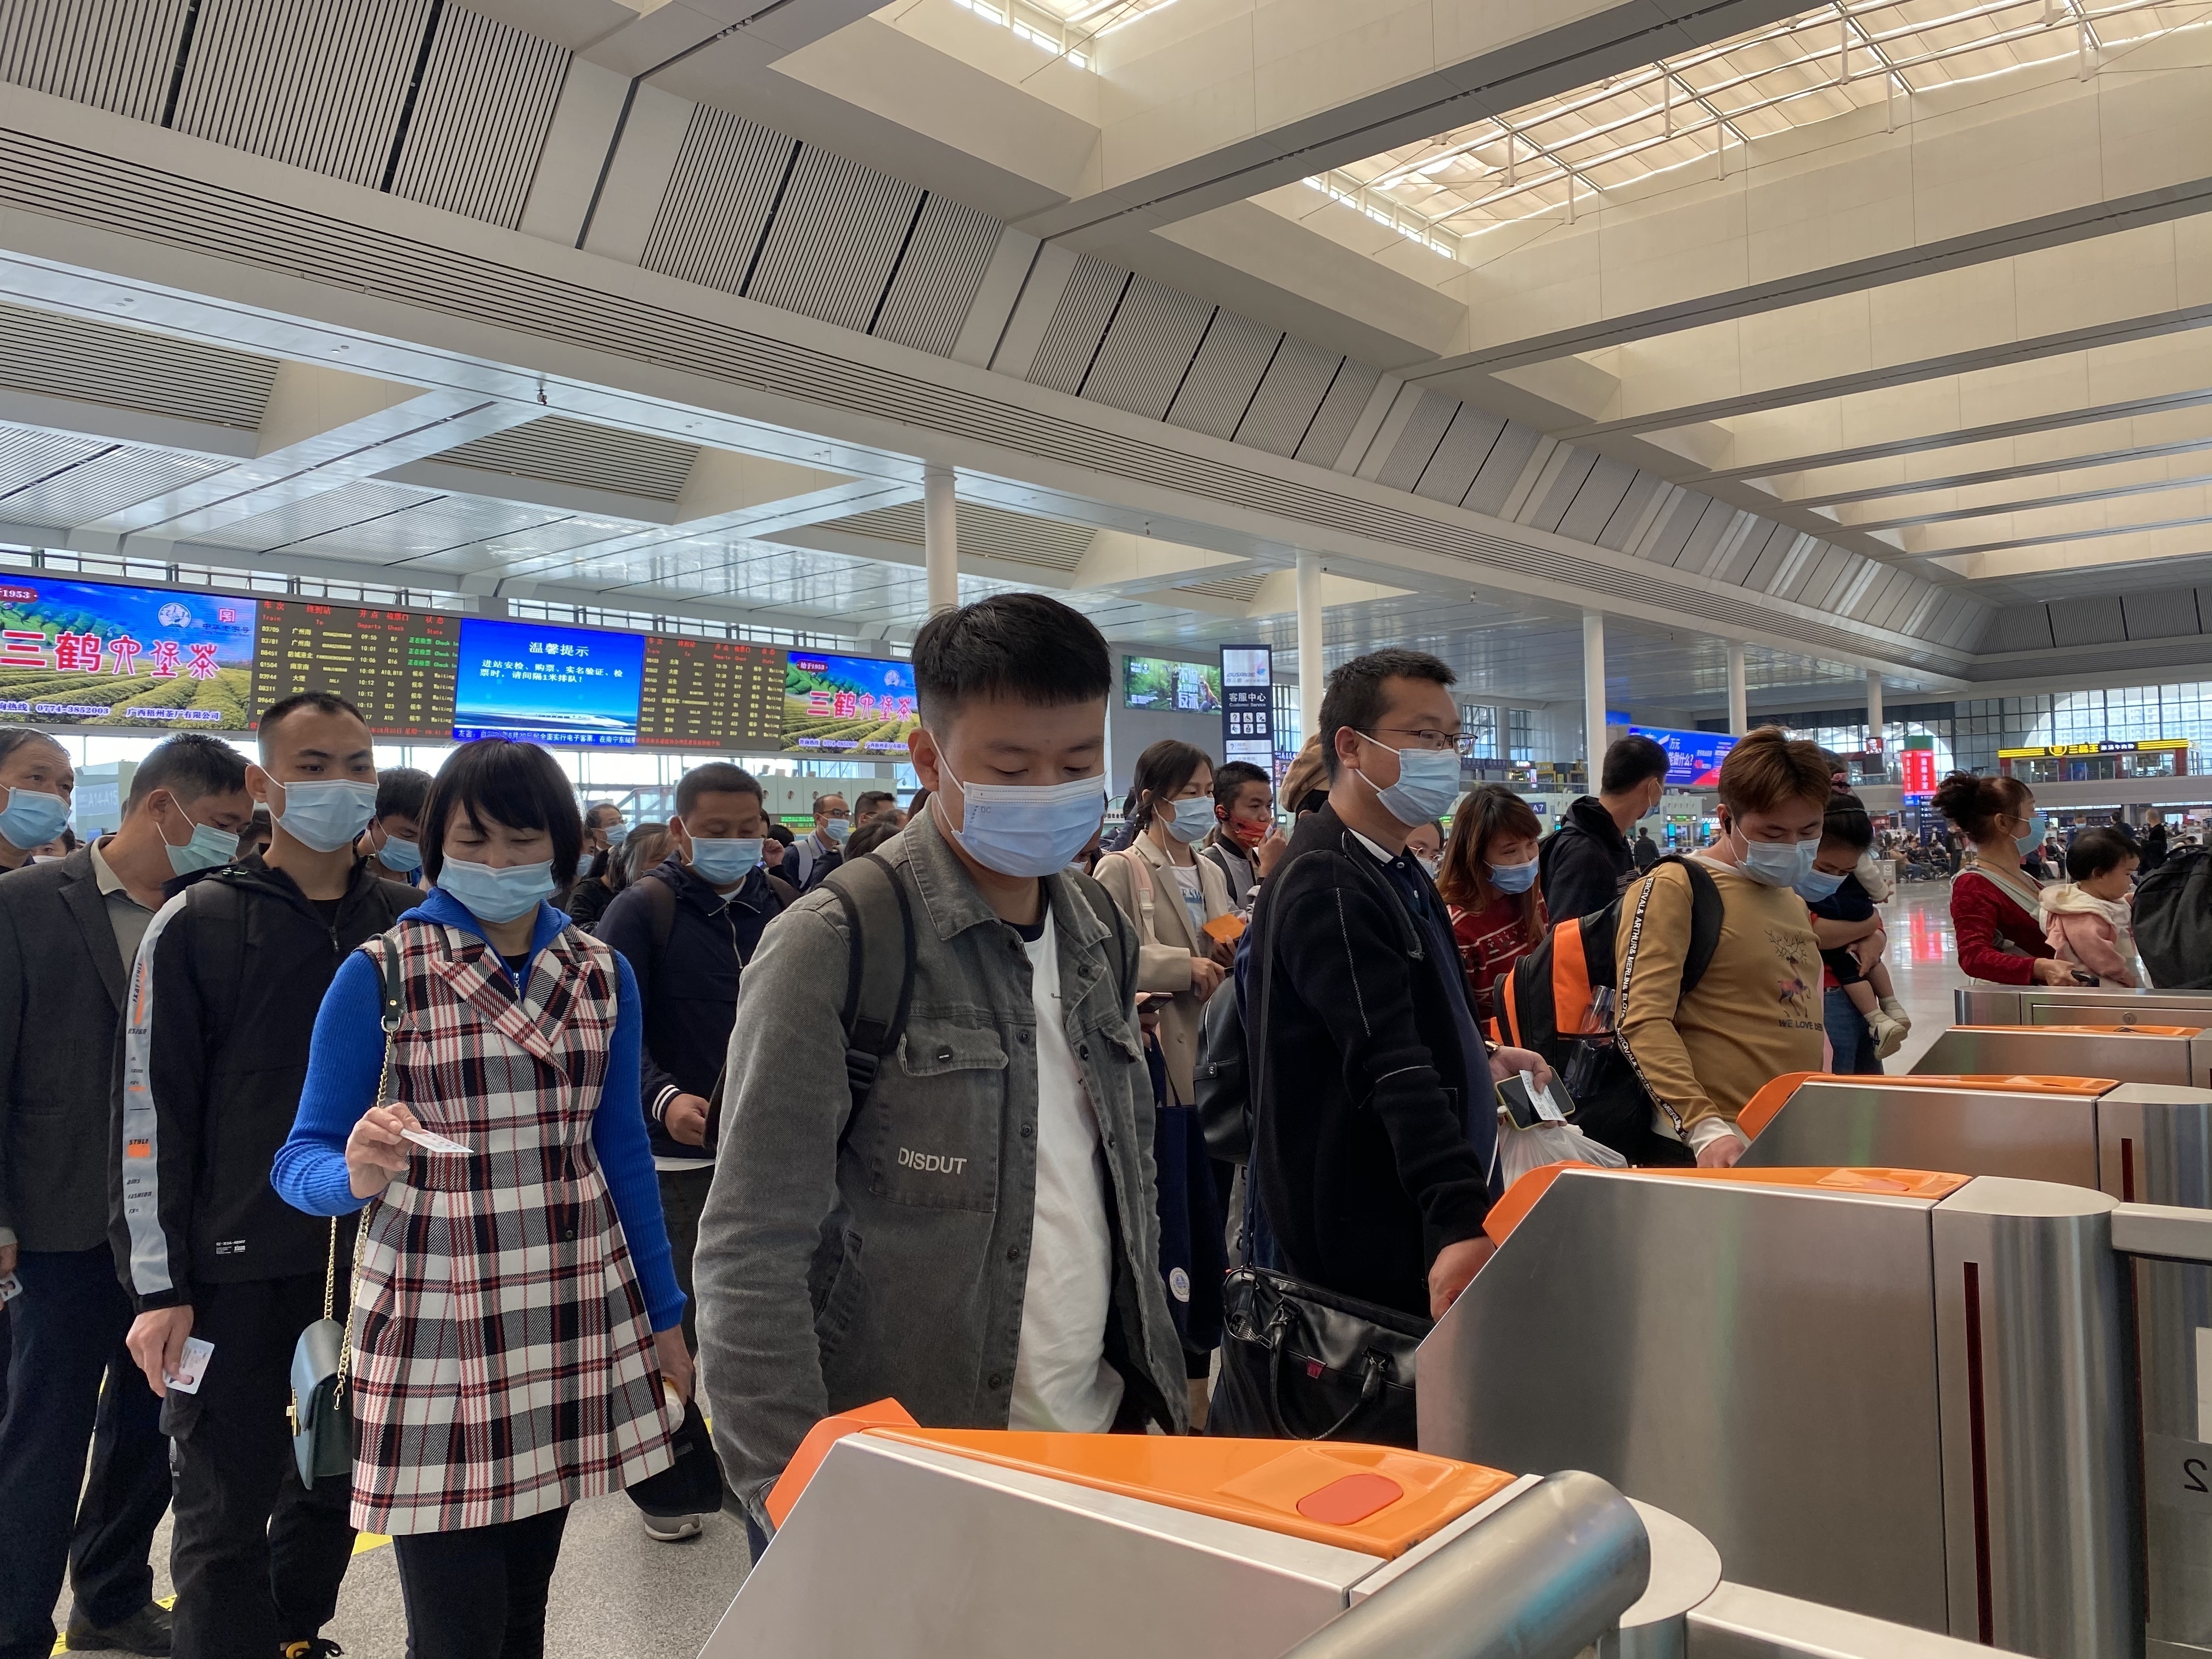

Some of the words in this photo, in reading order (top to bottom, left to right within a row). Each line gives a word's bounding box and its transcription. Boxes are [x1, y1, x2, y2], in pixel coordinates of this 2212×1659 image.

[387, 612, 409, 621] 检票口
[529, 641, 590, 657] 温馨提示
[482, 659, 623, 678] 进站安检、购票、实名验证、检
[1178, 693, 1199, 709] 反派
[1229, 692, 1266, 702] 客服中心
[37, 704, 109, 714] 0774-3852003
[127, 708, 220, 720] 广西梧州茶厂有限公司
[866, 742, 908, 750] 广西梧州茶厂有限公
[2068, 744, 2099, 754] 三品王
[89, 791, 117, 808] A14-A15
[1533, 804, 1544, 812] A7
[1629, 916, 1643, 955] ARTHUR&
[1779, 1019, 1793, 1028] WE
[1796, 1020, 1813, 1030] LOVE
[898, 1146, 967, 1175] DISDUT
